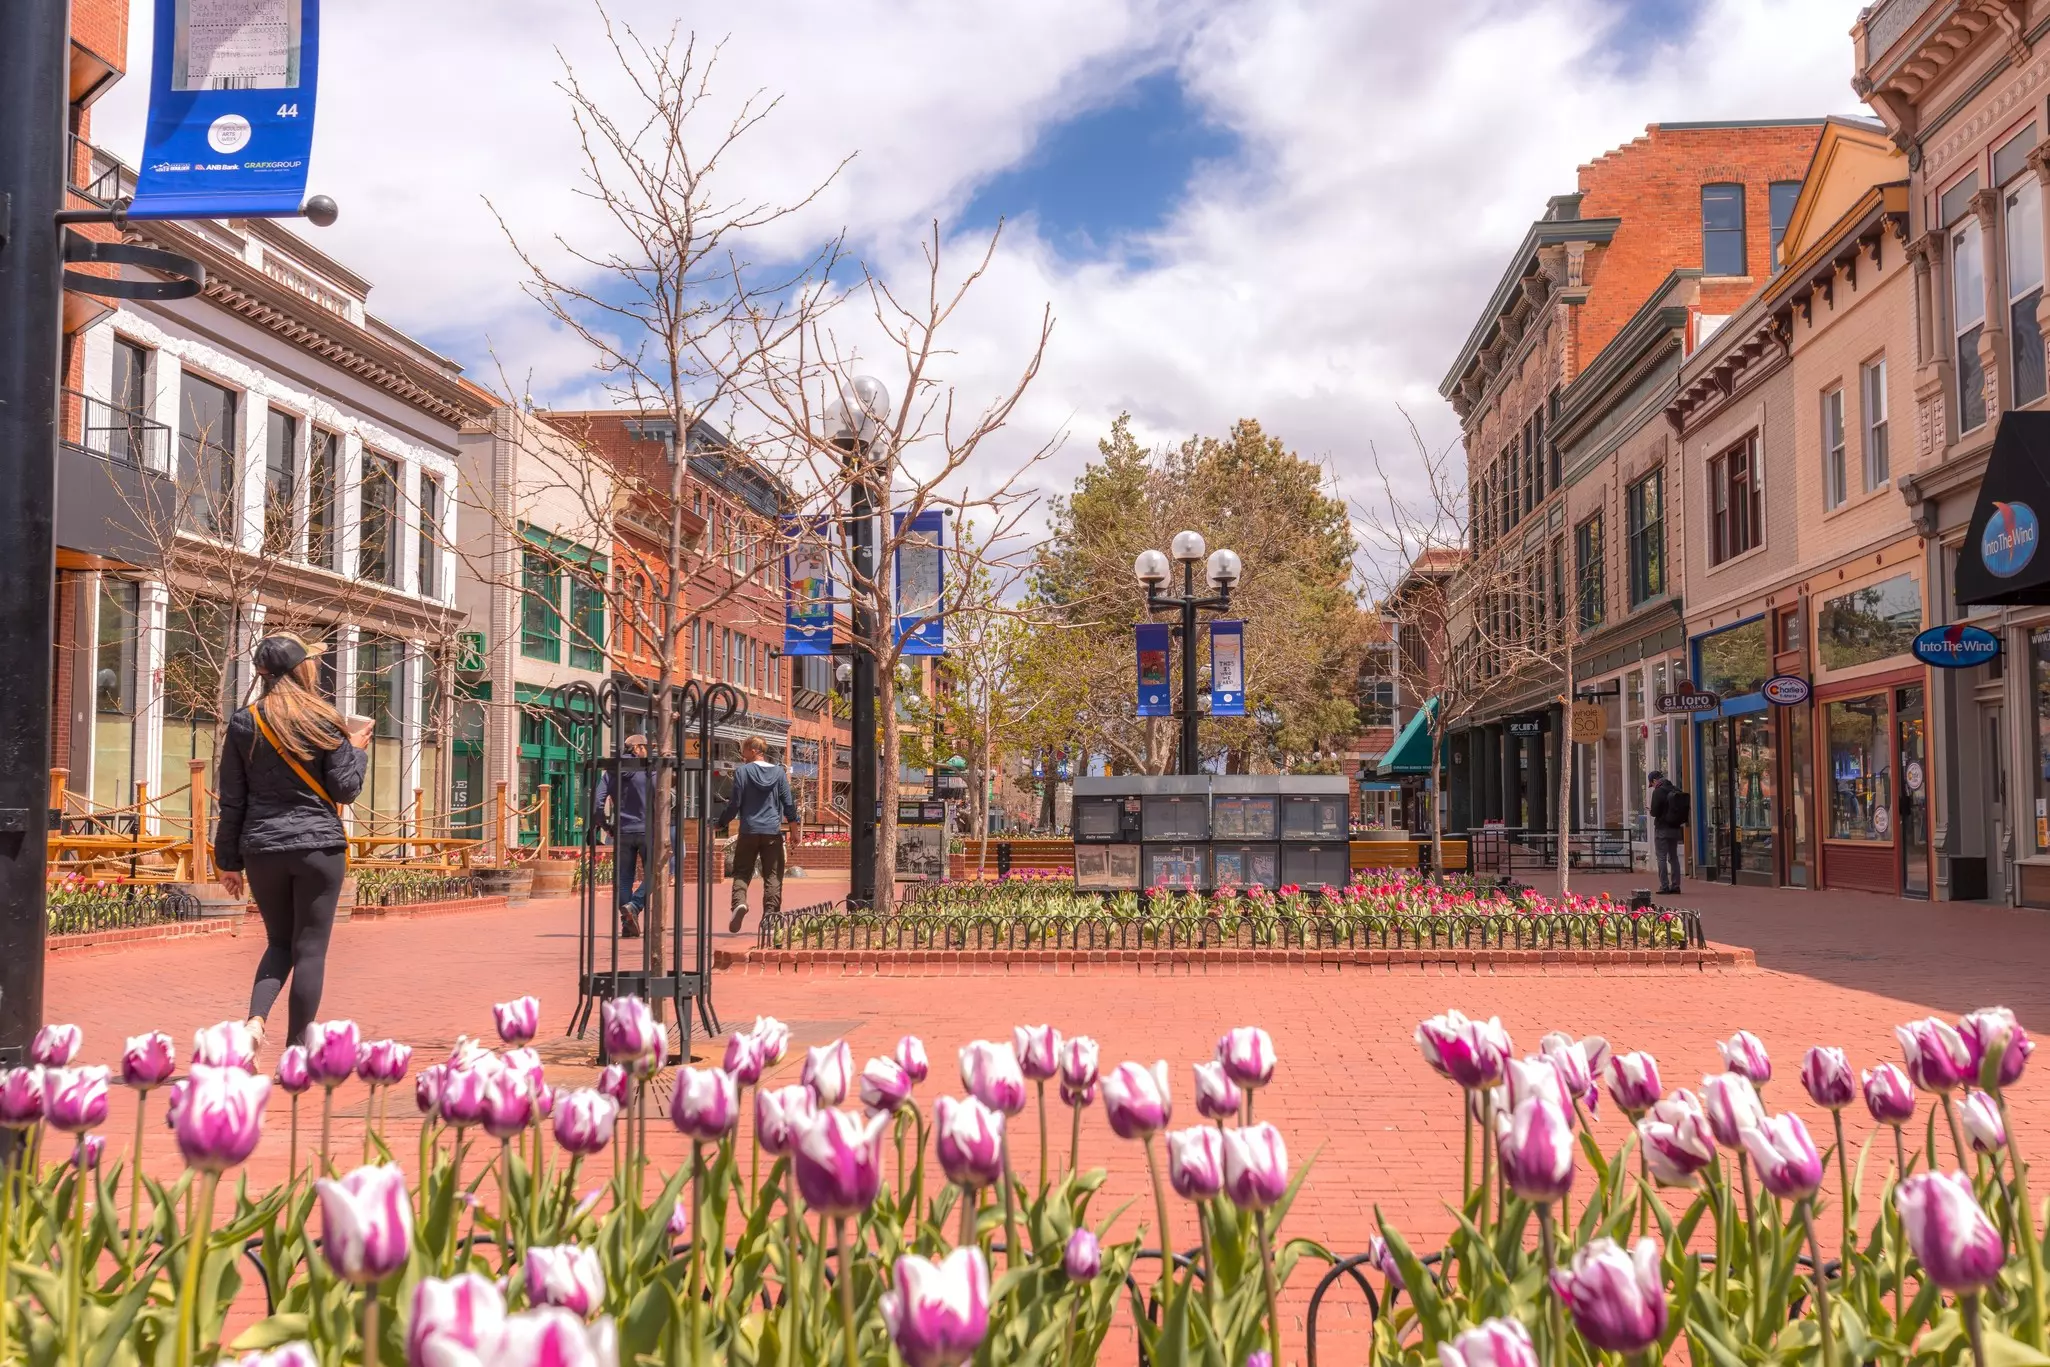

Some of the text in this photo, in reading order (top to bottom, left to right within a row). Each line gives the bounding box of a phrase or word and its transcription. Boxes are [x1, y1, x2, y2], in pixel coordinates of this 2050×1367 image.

[276, 104, 298, 118] 44
[244, 160, 302, 169] GRAFXGROUP
[1984, 522, 2034, 556] Into The Wind
[1920, 640, 1994, 652] Into The Wind
[1664, 695, 1710, 707] el loro
[1573, 708, 1598, 717] whole
